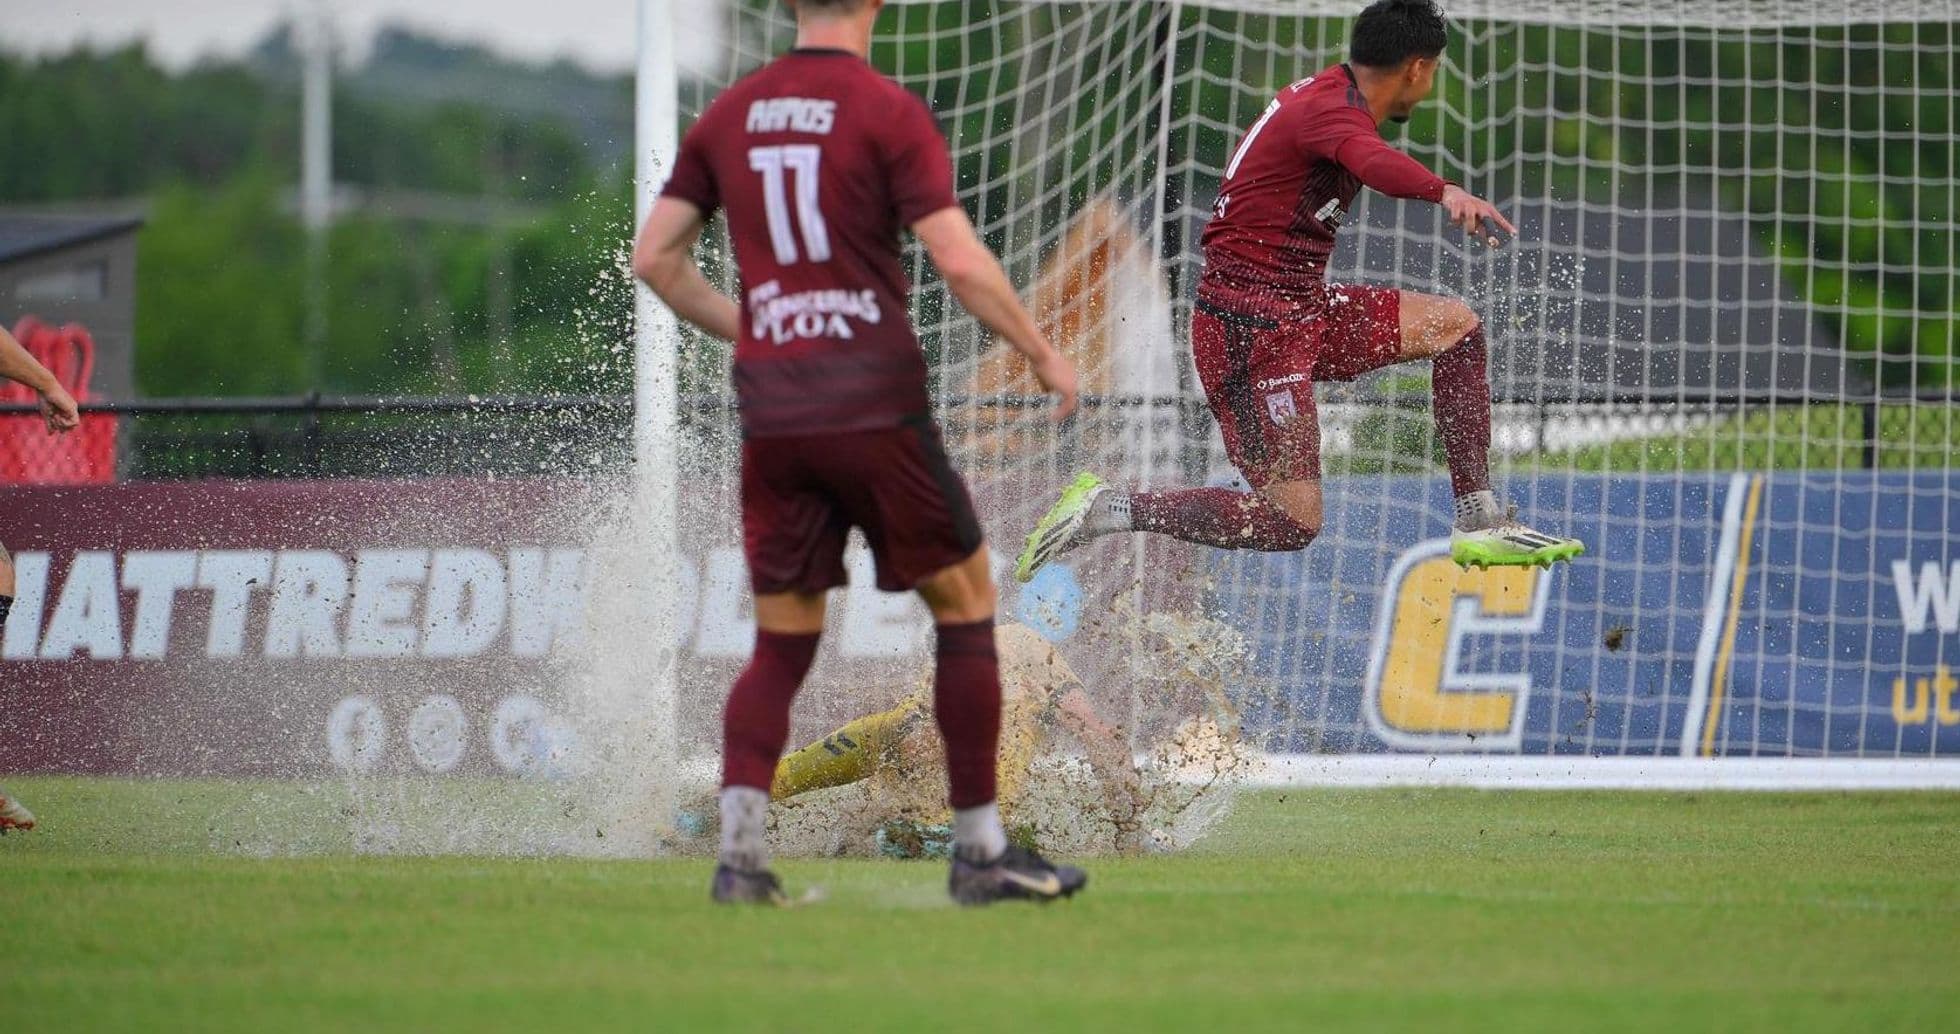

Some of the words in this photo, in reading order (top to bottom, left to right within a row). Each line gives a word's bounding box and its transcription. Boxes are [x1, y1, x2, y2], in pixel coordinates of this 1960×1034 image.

[746, 96, 837, 134] RAMOS
[748, 143, 831, 265] 11
[1363, 538, 1553, 752] C
